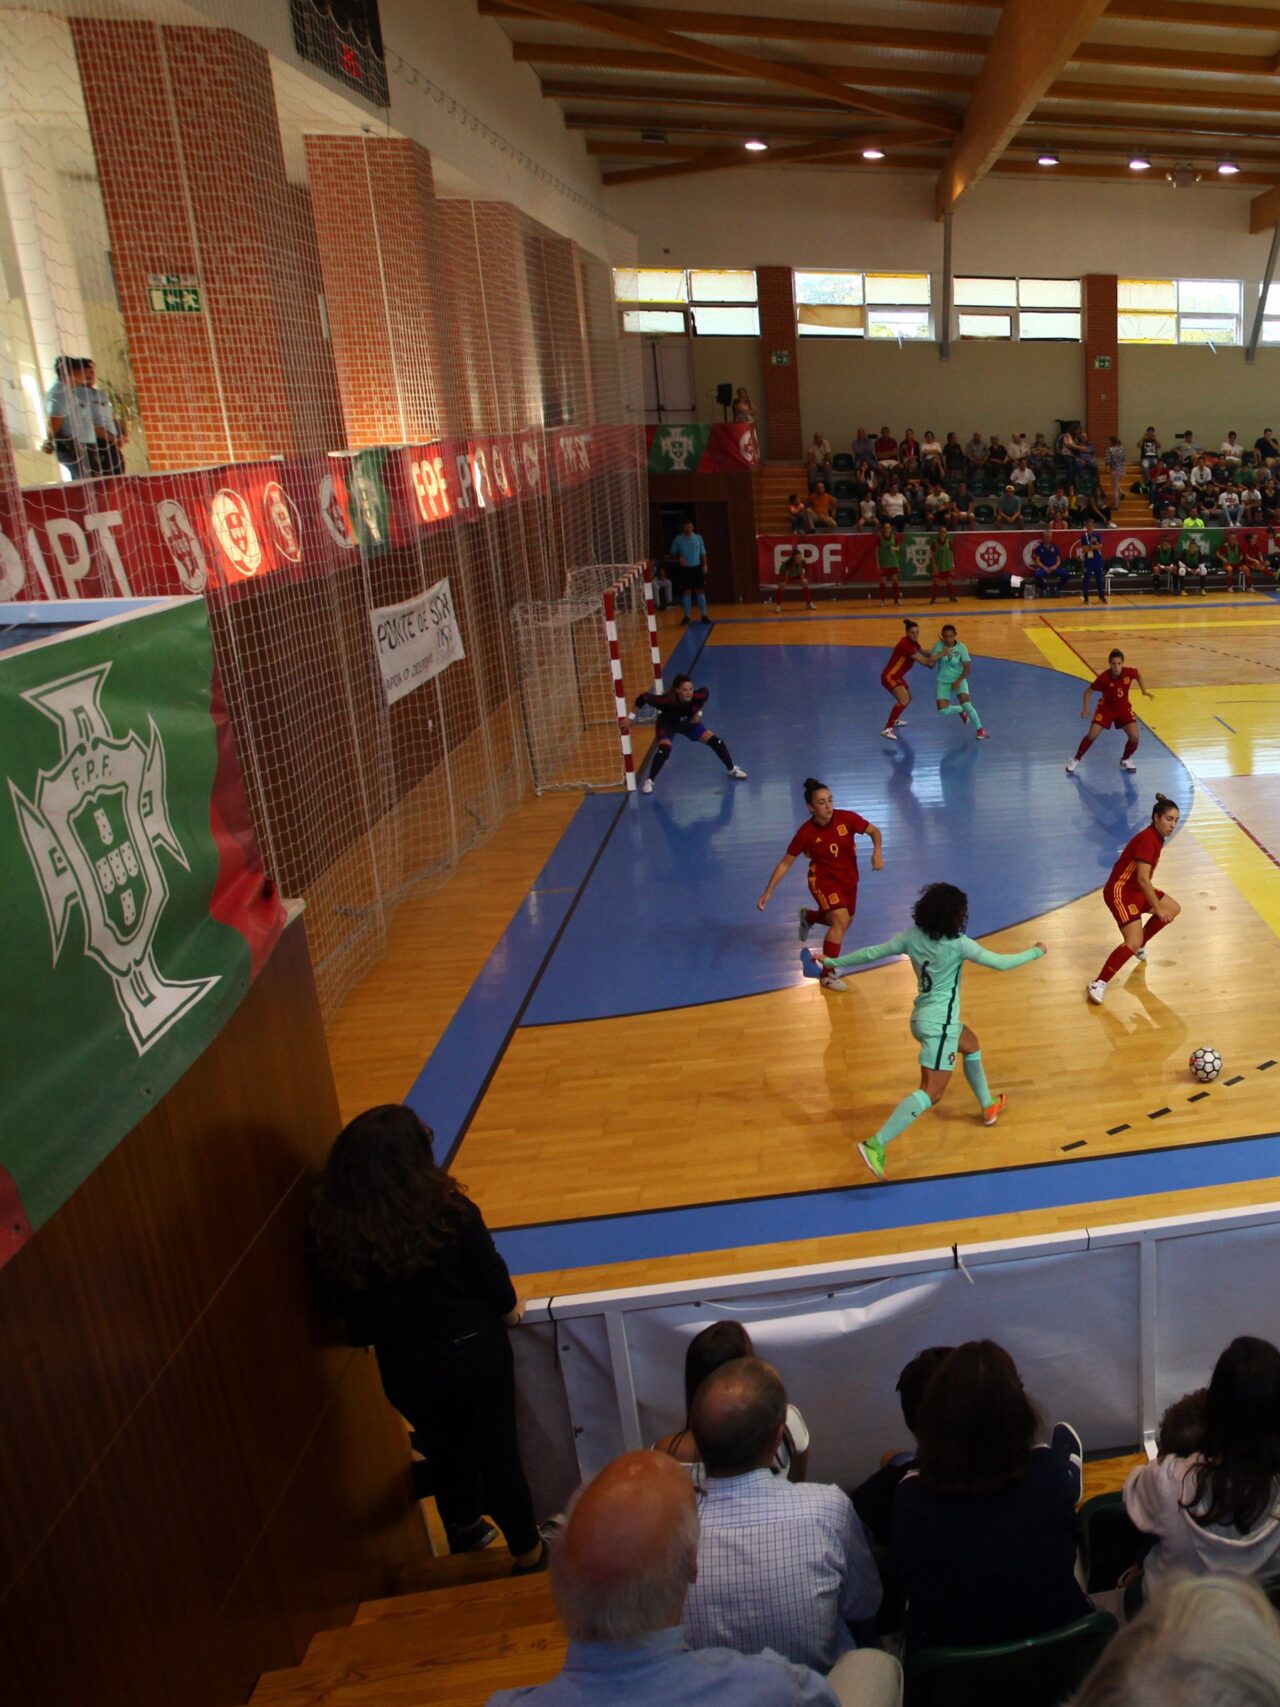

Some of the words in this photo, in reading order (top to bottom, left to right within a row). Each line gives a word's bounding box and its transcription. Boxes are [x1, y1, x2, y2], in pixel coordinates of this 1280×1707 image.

[377, 610, 415, 654] PONTE
[1117, 688, 1124, 697] 5
[72, 754, 111, 791] F.P.F.
[829, 843, 838, 857] 9
[920, 960, 933, 993] 6
